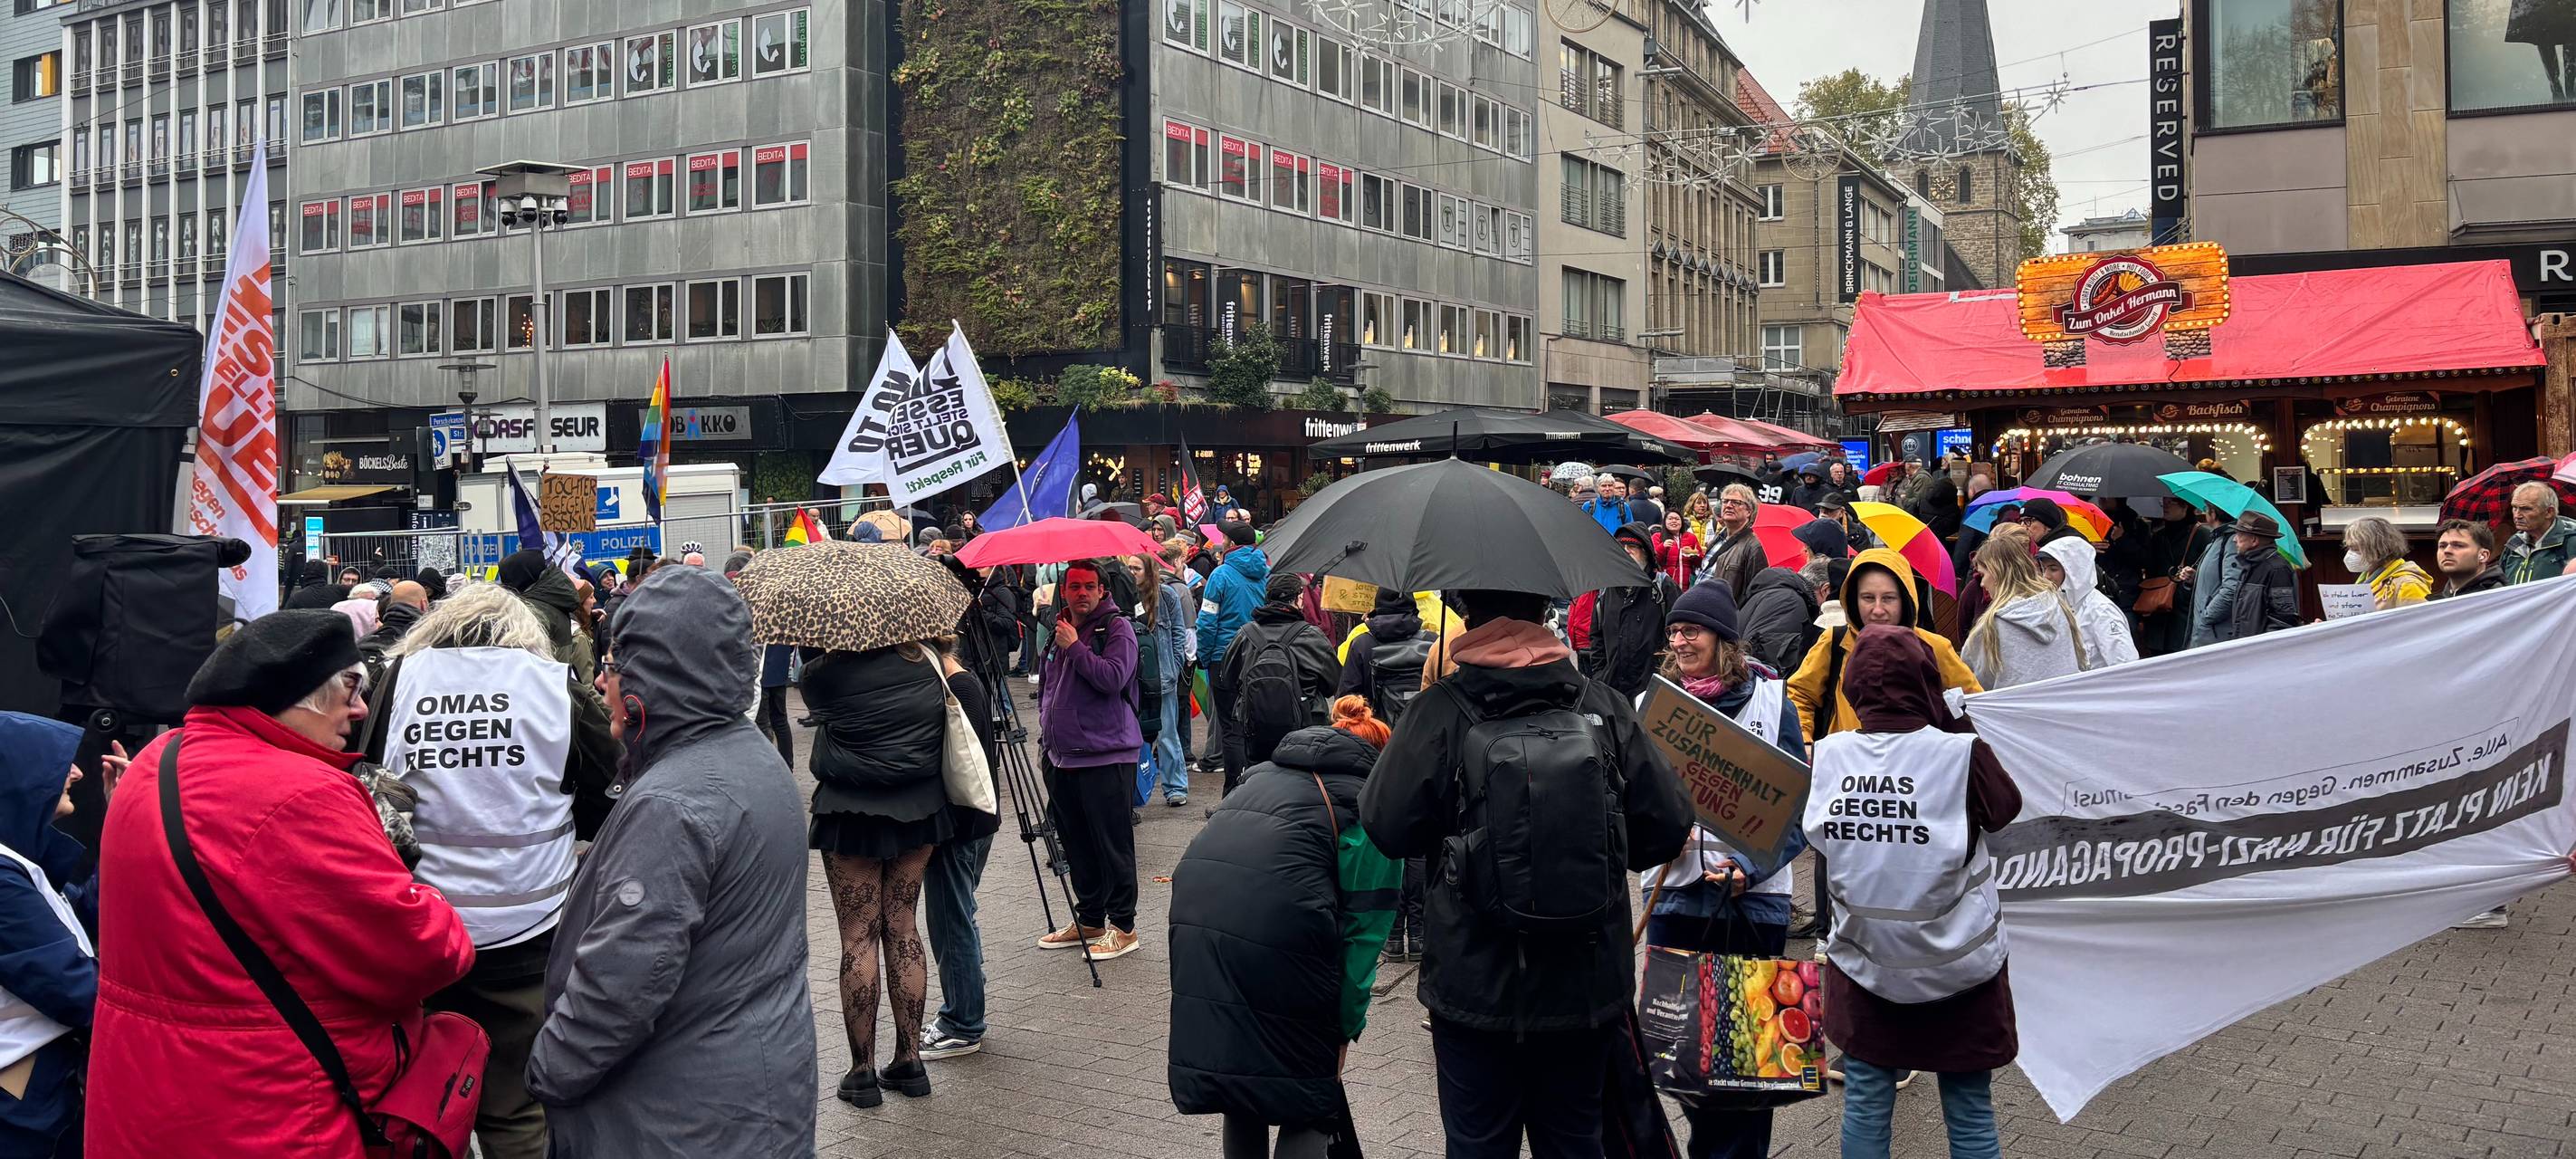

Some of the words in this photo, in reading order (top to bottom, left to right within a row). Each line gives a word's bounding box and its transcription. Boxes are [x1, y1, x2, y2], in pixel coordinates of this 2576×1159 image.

[2155, 33, 2178, 202] RESERVED
[1167, 125, 1190, 139] BEDITA
[1223, 140, 1244, 153] BEDITA
[757, 149, 784, 161] BEDITA
[1274, 153, 1293, 166] BEDITA
[691, 158, 717, 168] BEDITA
[568, 173, 591, 184] BEDITA
[627, 166, 653, 177] BEDITA
[1320, 167, 1338, 177] BEDITA
[456, 187, 478, 196] BEDITA
[352, 200, 373, 209] BEDITA
[403, 194, 425, 204] BEDITA
[1844, 185, 1853, 219] LANGE
[303, 206, 324, 215] BEDITA
[1907, 209, 1918, 292] DEICHMANN
[1845, 229, 1854, 292] BRINCKMANN
[2104, 263, 2120, 272] MORE
[2126, 263, 2137, 271] HOT
[2137, 266, 2152, 279] FOOD
[2068, 317, 2093, 330] Zum
[2094, 302, 2125, 324] Onkel
[2127, 288, 2177, 309] Hermann
[1323, 312, 1332, 372] frittenwerk
[2187, 403, 2243, 417] Backfisch
[2370, 401, 2436, 415] Champignons
[2047, 414, 2104, 426] Champignons
[1366, 439, 1421, 453] frittenwerk
[2059, 473, 2102, 483] bohnen
[545, 476, 597, 495] TÖCHTER
[416, 693, 510, 715] OMAS
[404, 718, 512, 745] GEGEN
[1668, 705, 1718, 745] FÜR
[405, 744, 525, 771] RECHTS
[1686, 761, 1744, 803] GEGEN
[1841, 775, 1914, 795] OMAS
[1828, 799, 1917, 819] GEGEN
[1823, 821, 1930, 845] RECHTS
